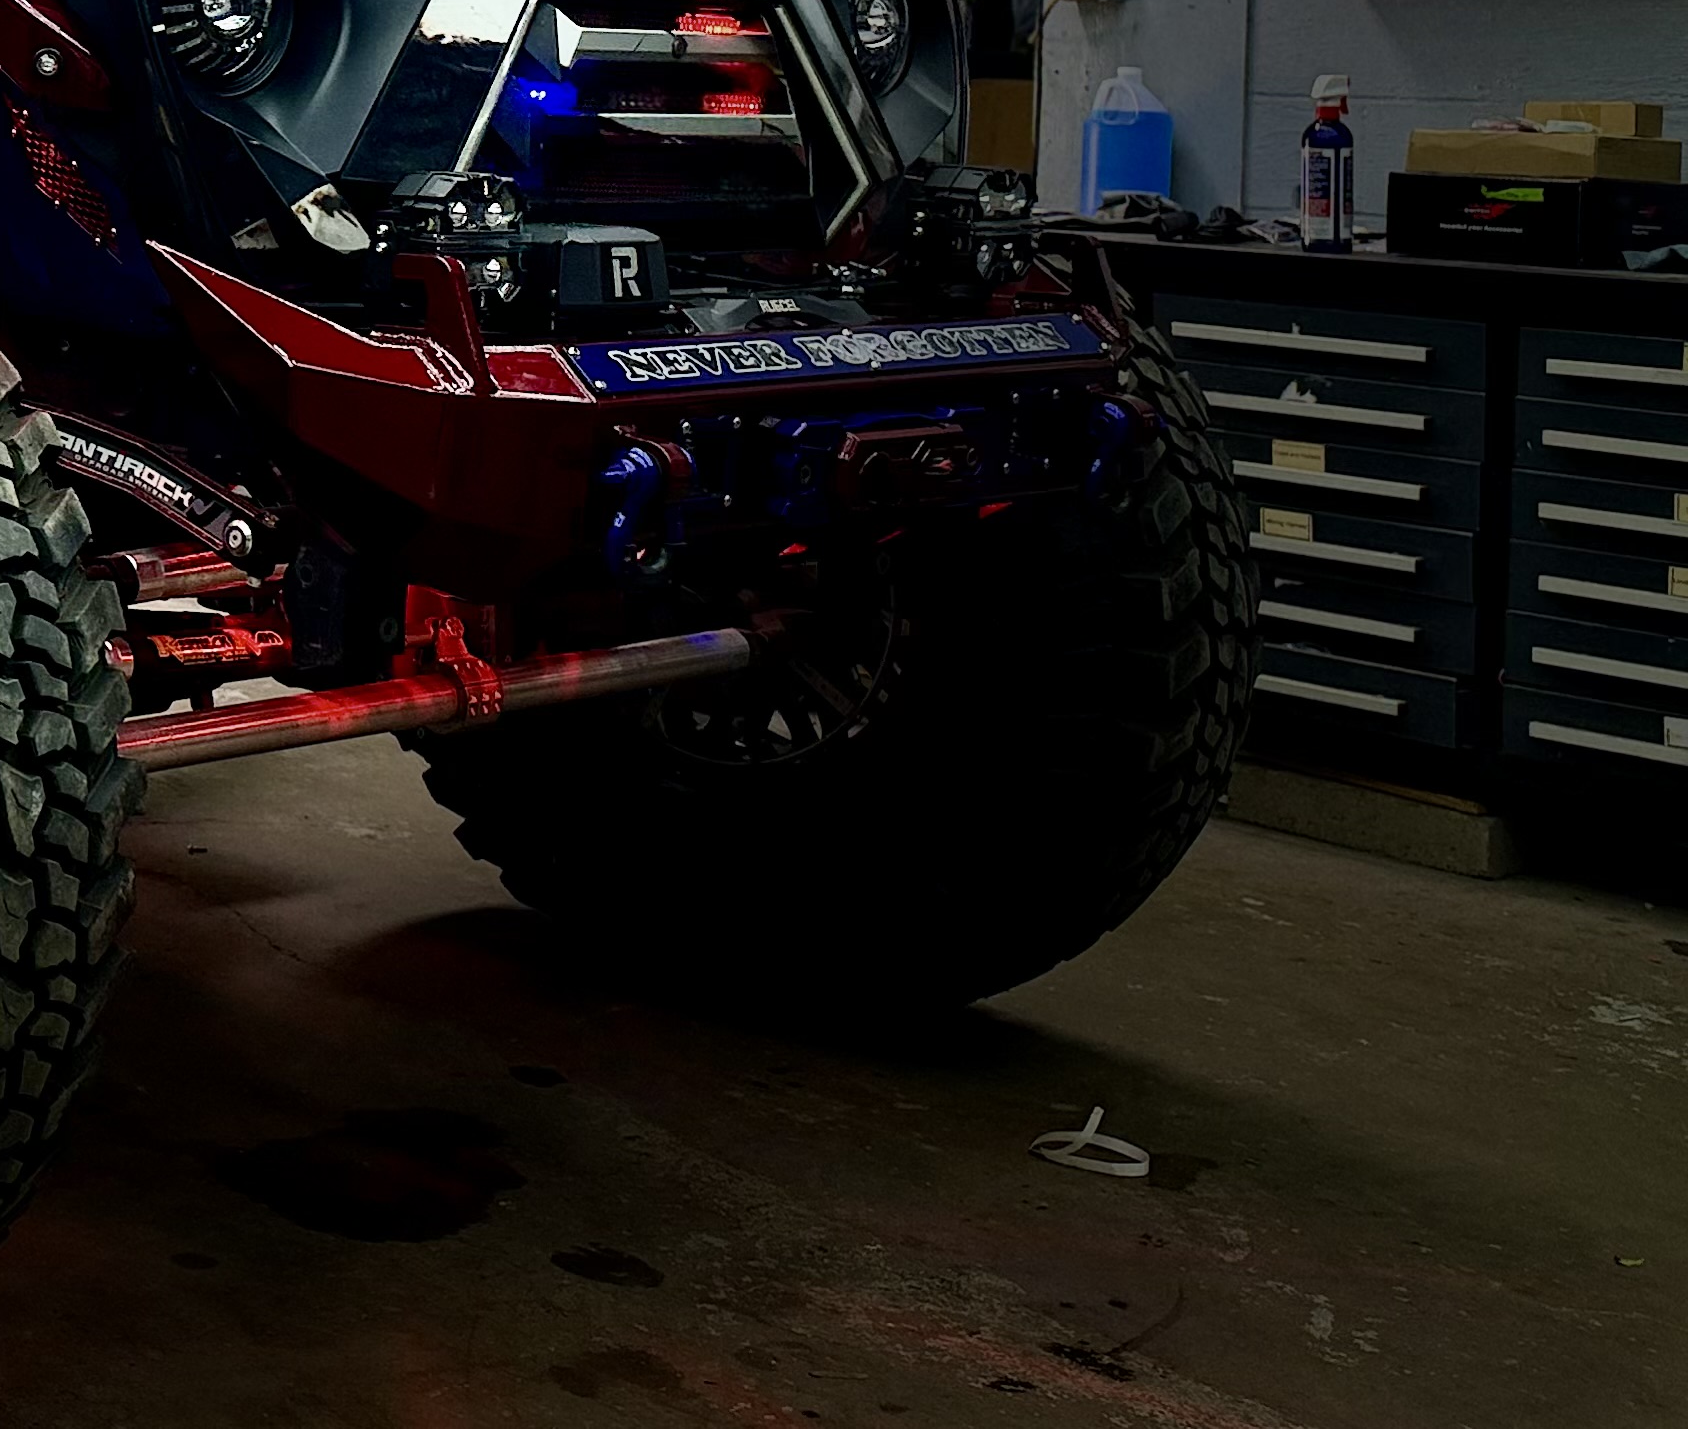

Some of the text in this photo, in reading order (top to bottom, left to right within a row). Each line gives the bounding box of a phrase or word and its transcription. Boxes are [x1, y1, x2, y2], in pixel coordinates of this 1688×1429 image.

[611, 247, 642, 298] R
[608, 321, 1071, 382] NEVER FORGOTTEN
[54, 430, 193, 509] ANTIROCK
